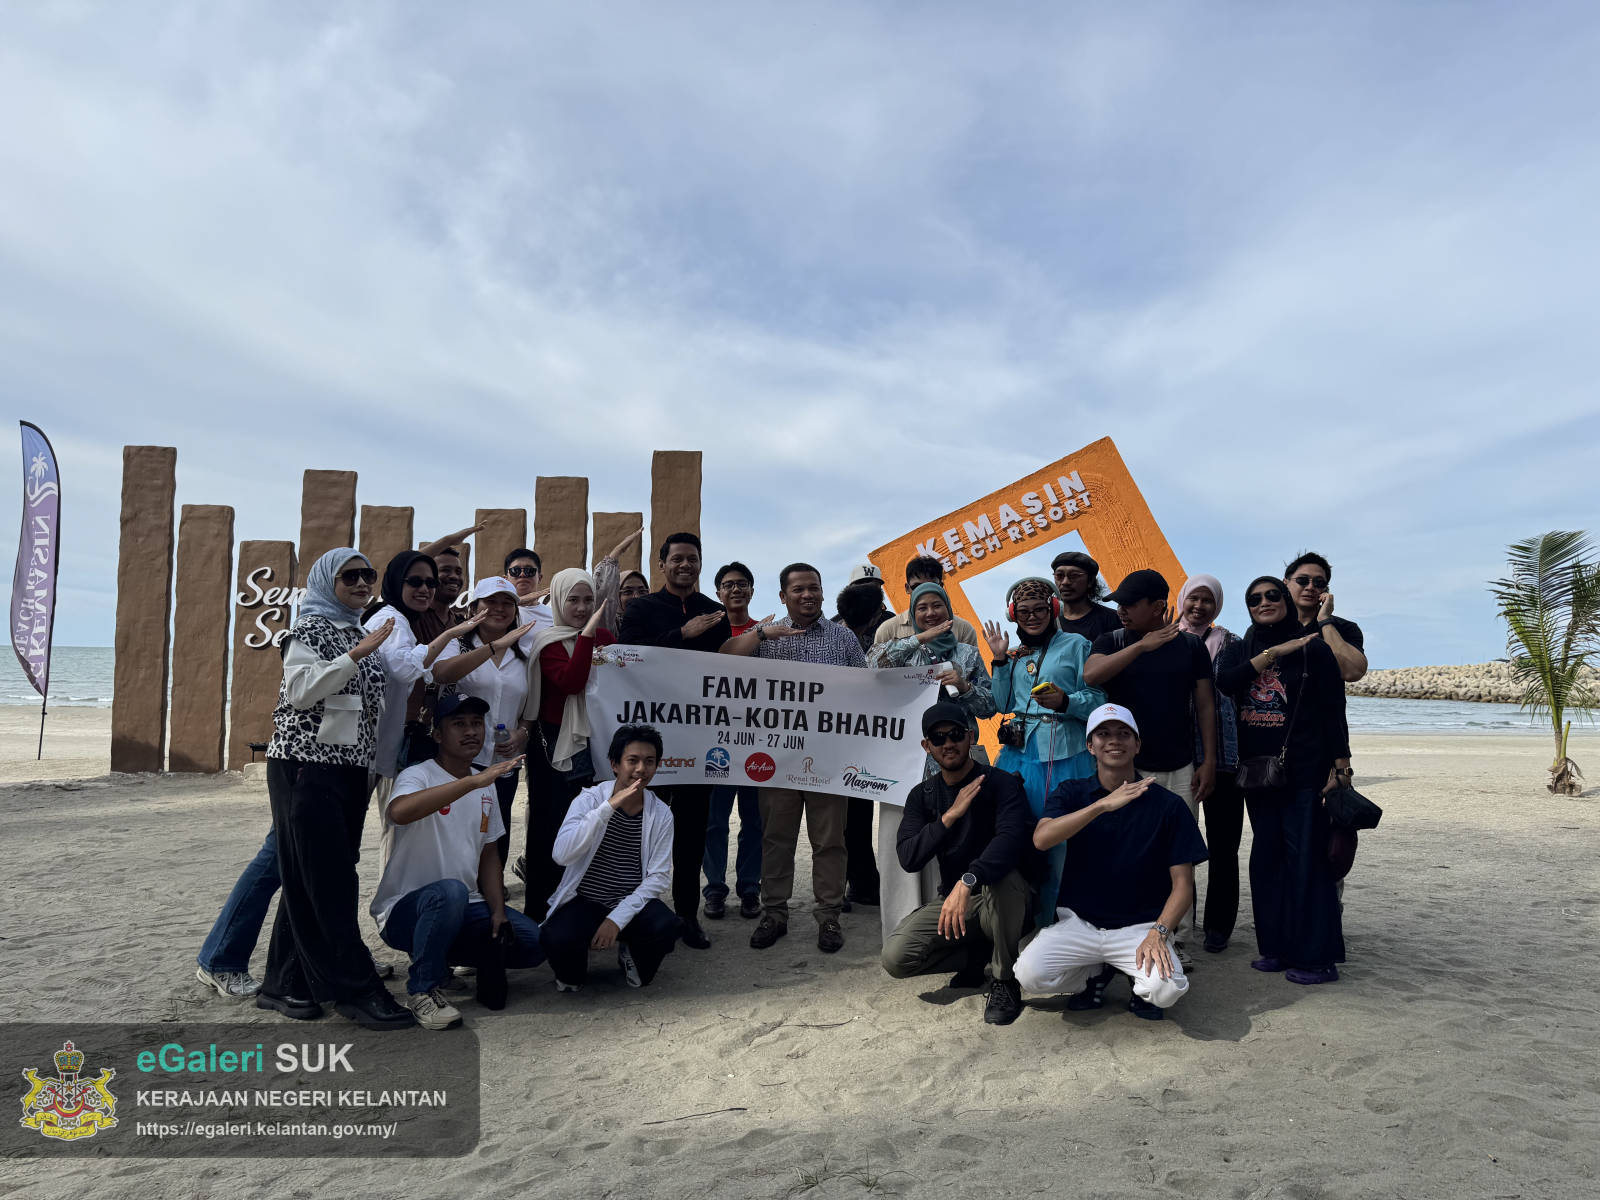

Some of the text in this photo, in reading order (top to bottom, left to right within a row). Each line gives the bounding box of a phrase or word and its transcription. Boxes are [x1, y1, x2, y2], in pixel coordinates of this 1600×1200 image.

[916, 470, 1087, 559] KEMASIN
[940, 492, 1092, 573] EACH RESORT
[862, 566, 876, 577] W
[702, 675, 825, 703] FAM TRIP
[616, 700, 906, 741] JAKARTA-KOTA BHARU
[717, 730, 731, 745] 24
[733, 731, 756, 746] JUN
[766, 733, 779, 748] 27
[782, 735, 806, 750] JUN
[809, 776, 831, 785] Hotel
[842, 772, 889, 792] Nasrom
